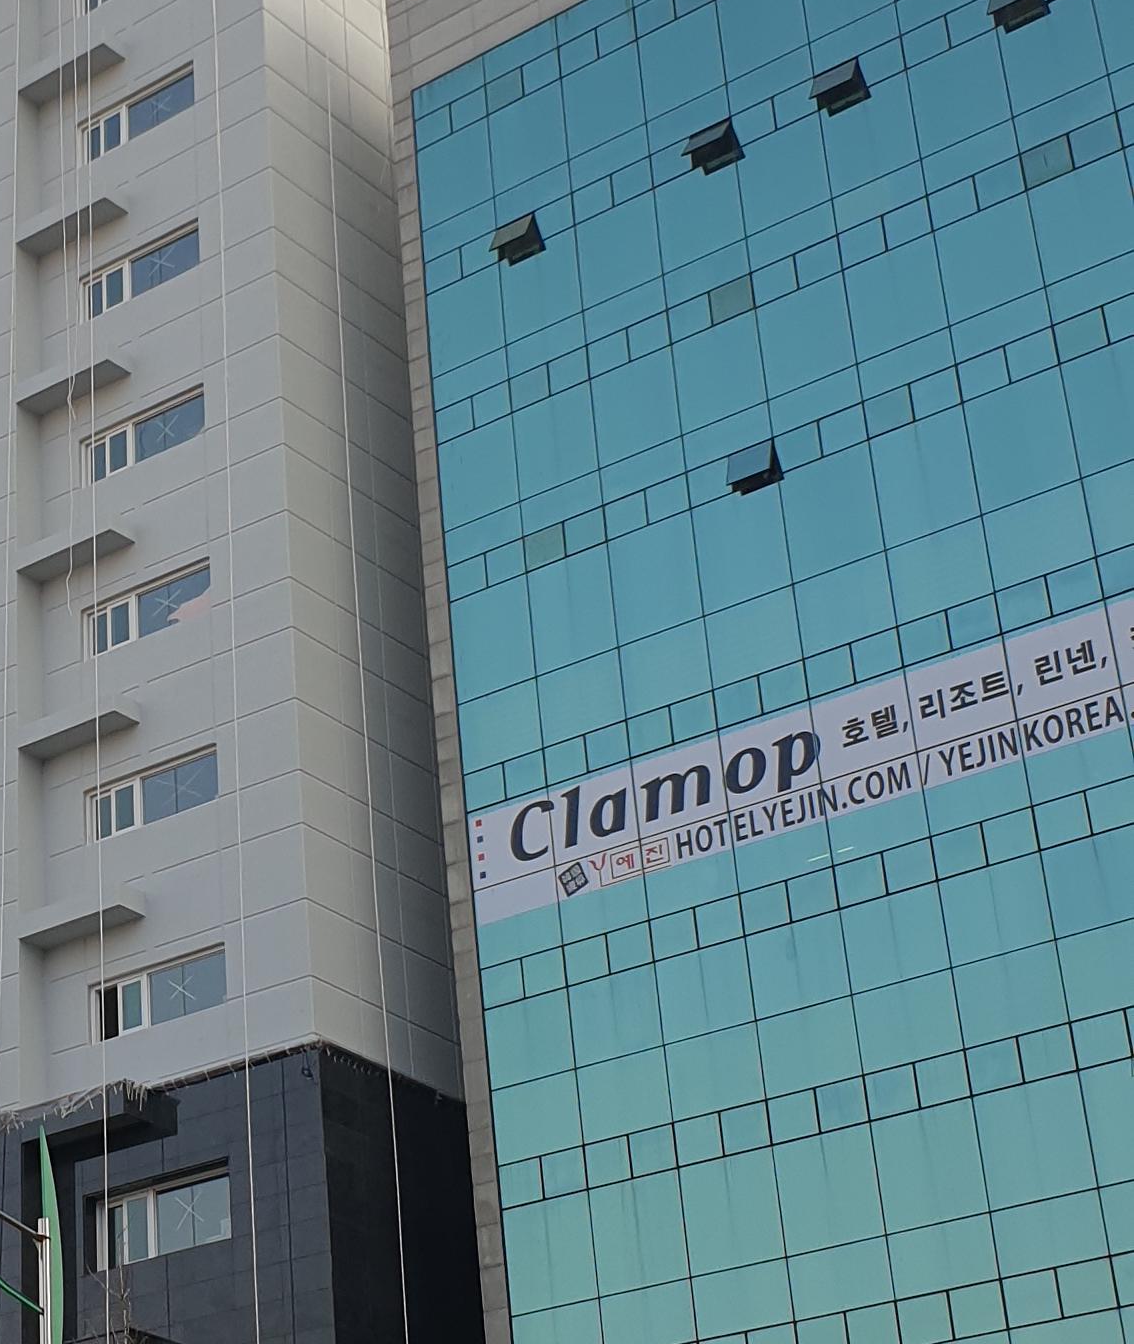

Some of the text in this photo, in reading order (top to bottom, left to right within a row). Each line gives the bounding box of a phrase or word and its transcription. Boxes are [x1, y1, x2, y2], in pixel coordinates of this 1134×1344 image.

[841, 639, 1107, 748] 호텔, 리조트, 린넨,
[509, 725, 821, 862] Clamop
[675, 761, 912, 859] HOTELYEJIN.COM
